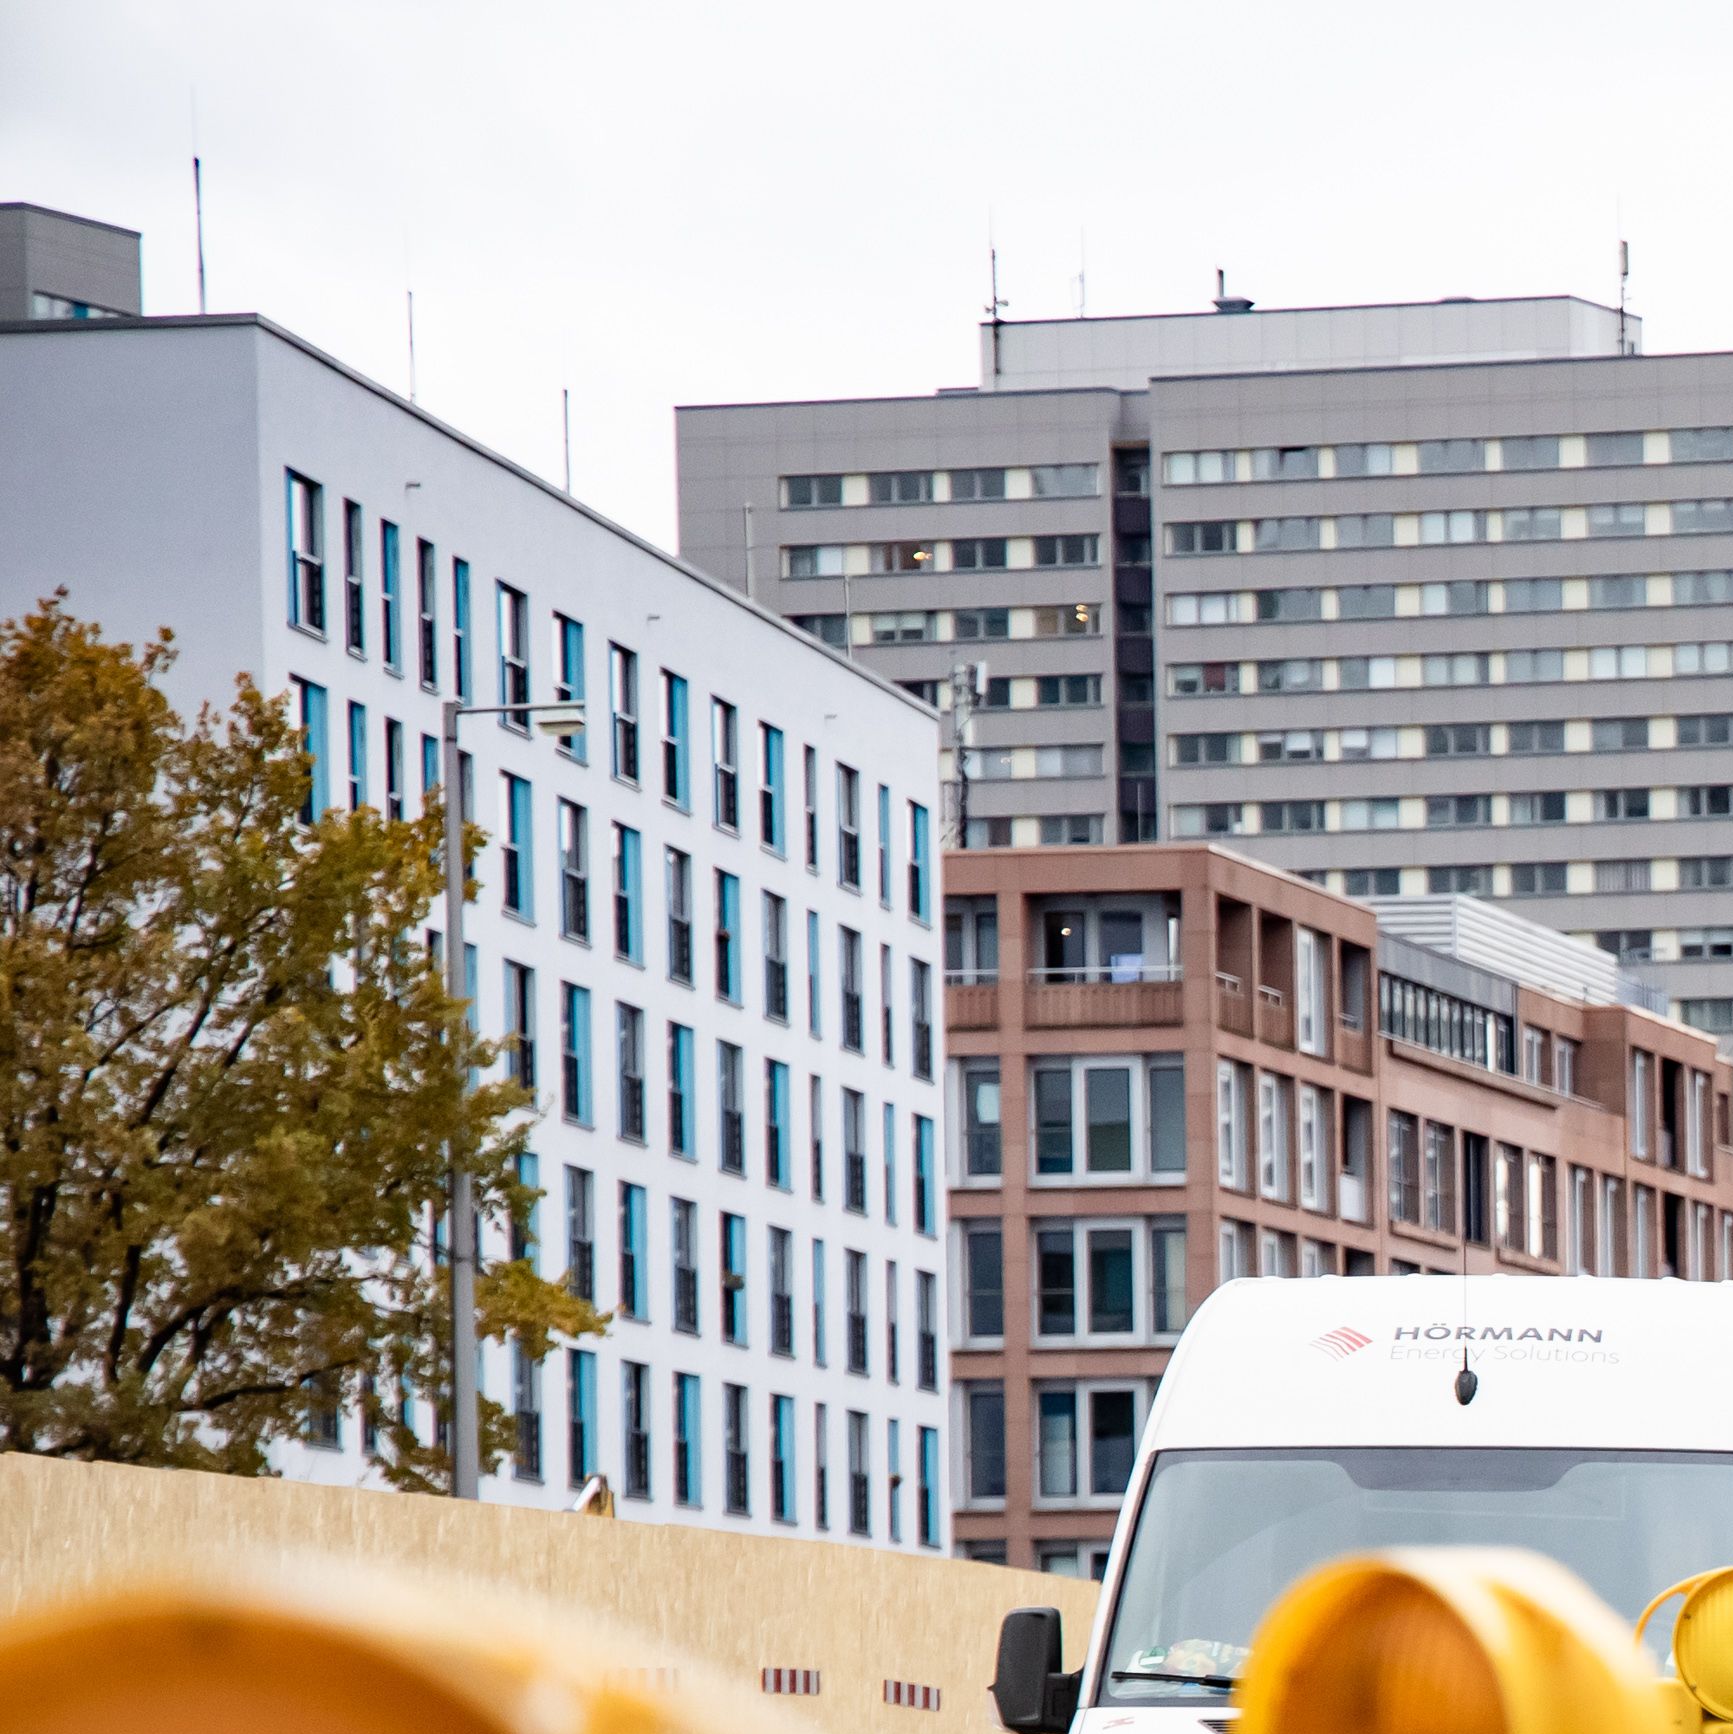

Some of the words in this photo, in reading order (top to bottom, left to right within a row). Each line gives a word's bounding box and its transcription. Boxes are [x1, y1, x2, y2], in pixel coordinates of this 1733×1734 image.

[1394, 1323, 1603, 1344] HÖRMANN
[1390, 1345, 1486, 1363] Energy
[1494, 1345, 1621, 1365] Solutions
